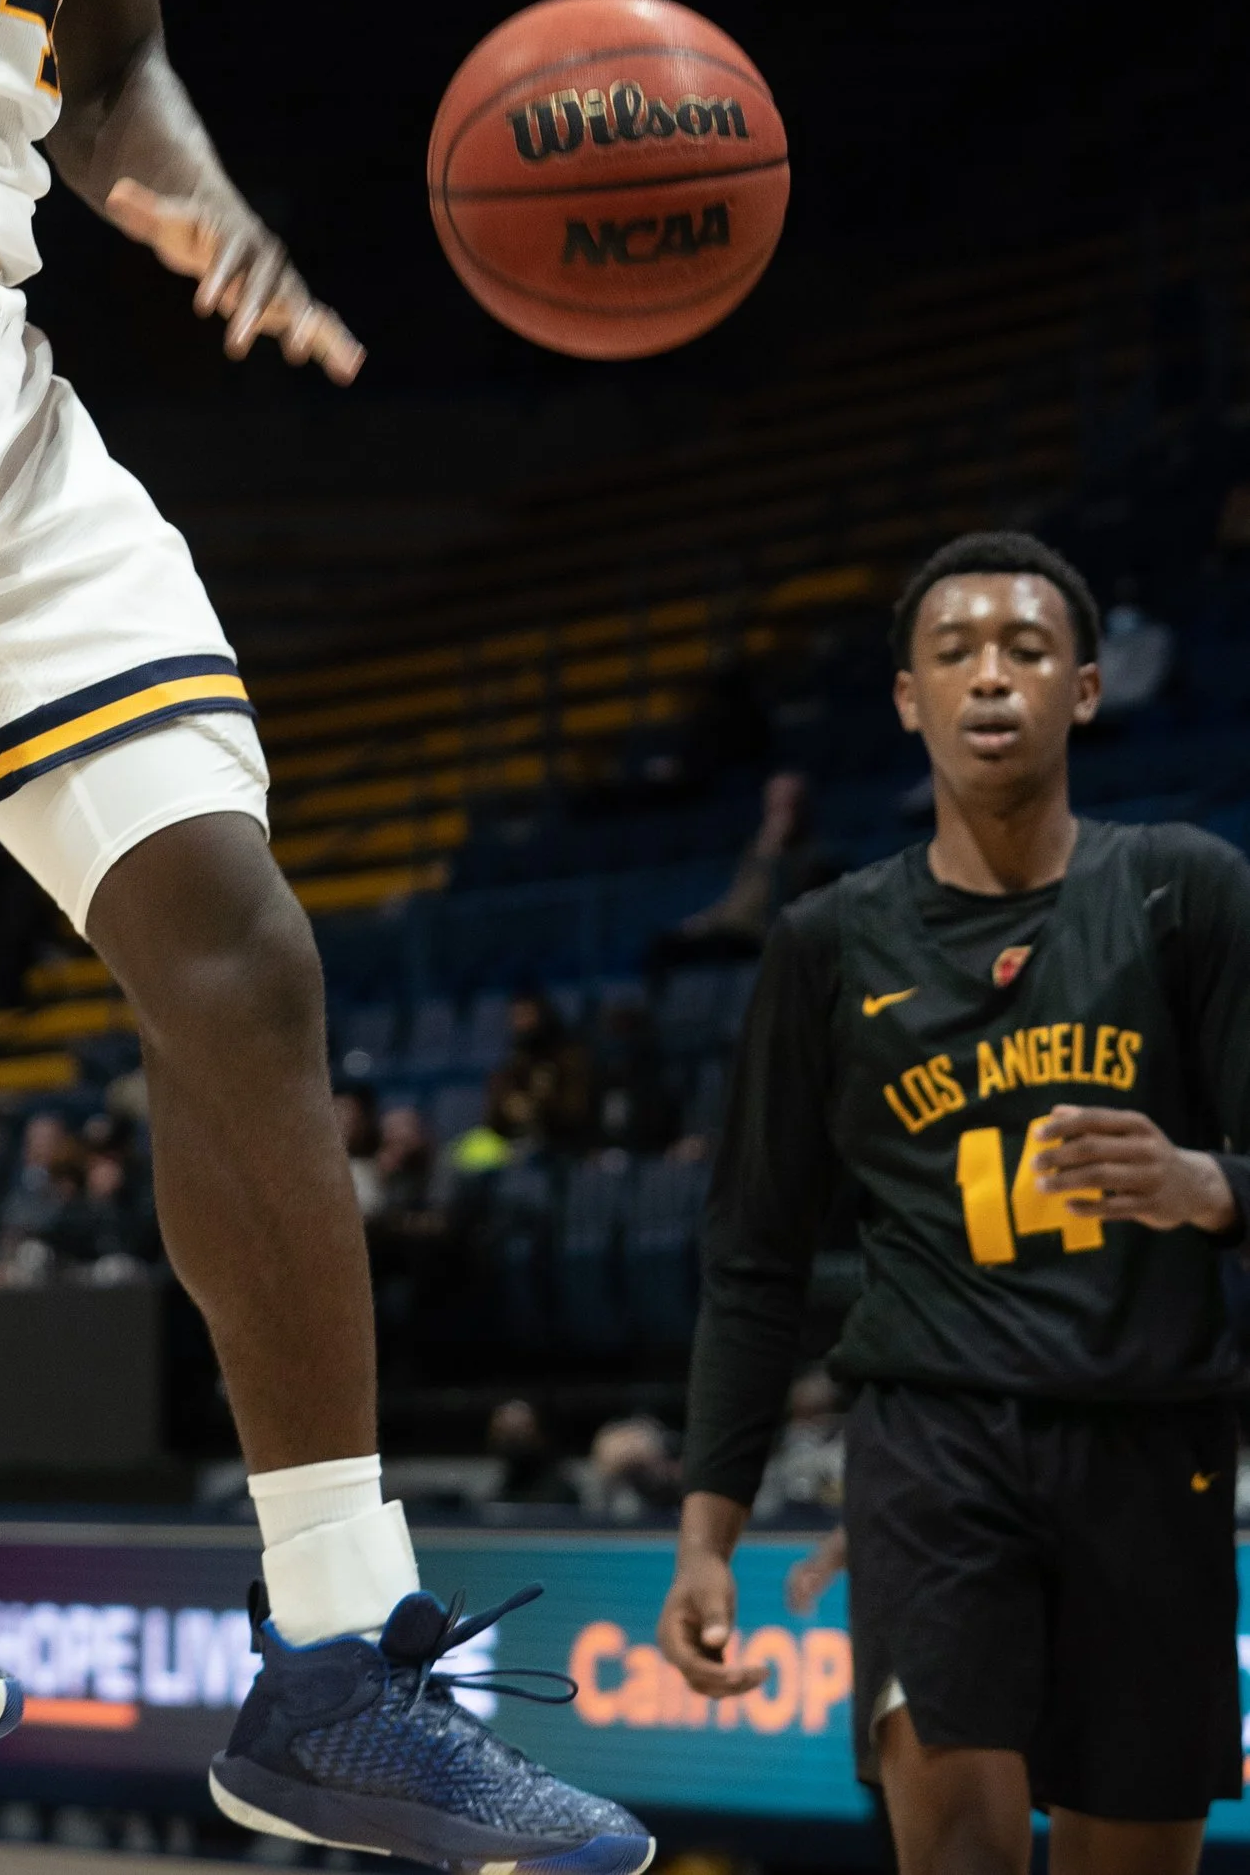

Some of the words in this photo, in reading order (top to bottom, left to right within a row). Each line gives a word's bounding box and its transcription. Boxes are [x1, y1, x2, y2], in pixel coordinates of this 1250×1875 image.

[506, 78, 749, 162] Wilson
[562, 199, 731, 265] NCAA
[883, 1054, 967, 1135] LOS
[977, 1022, 1142, 1099] ANGELES
